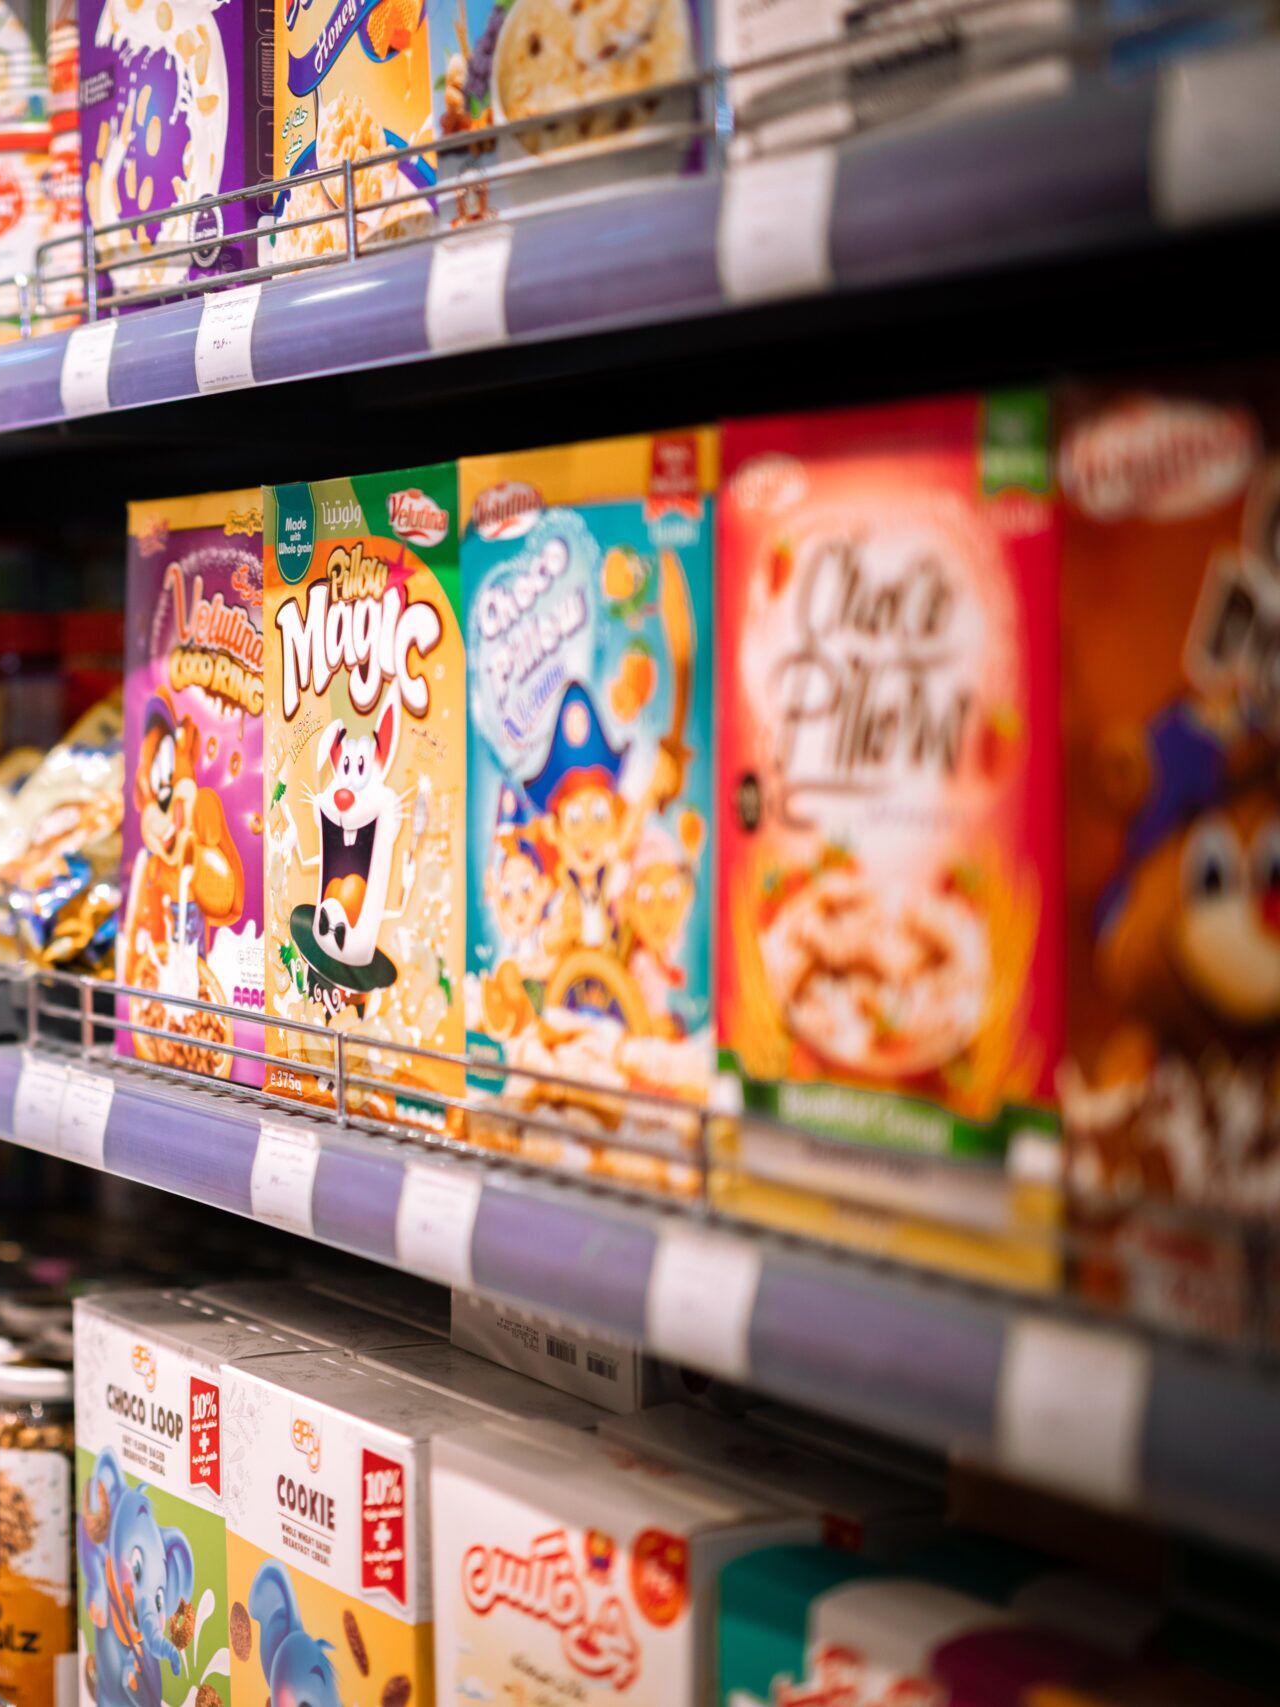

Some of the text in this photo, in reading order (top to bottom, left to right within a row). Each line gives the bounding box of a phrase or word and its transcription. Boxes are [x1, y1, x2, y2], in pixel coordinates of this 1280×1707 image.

[285, 517, 308, 532] Made
[321, 499, 363, 531] ولوتینا
[389, 494, 450, 531] Velutina
[278, 542, 312, 557] Whole grain
[290, 532, 302, 541] with
[328, 541, 390, 602] Pillow
[164, 562, 263, 674] Velutina
[275, 579, 442, 722] Magic
[107, 1383, 184, 1442] CHOCO LOOP
[192, 1391, 217, 1420] 10%
[277, 1474, 335, 1531] COOKIE
[364, 1468, 401, 1505] 10%
[282, 1535, 310, 1556] BREAKFAST
